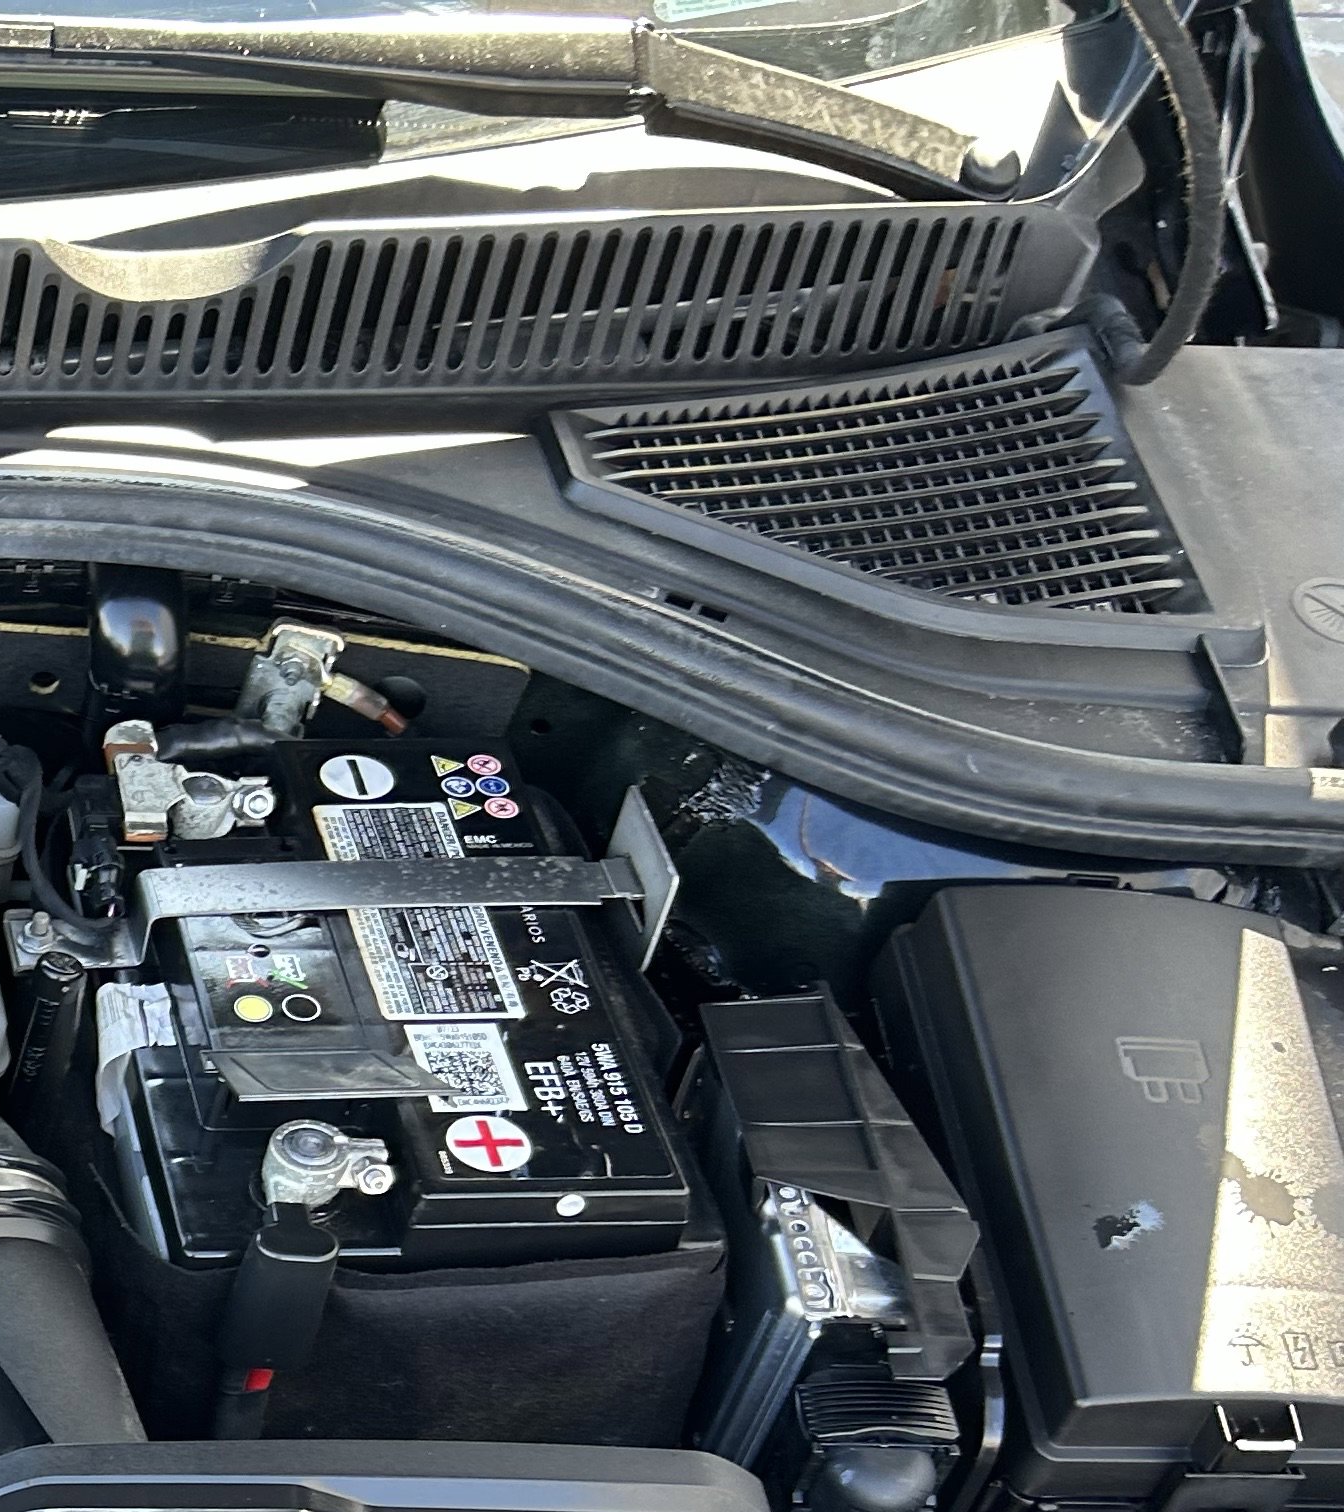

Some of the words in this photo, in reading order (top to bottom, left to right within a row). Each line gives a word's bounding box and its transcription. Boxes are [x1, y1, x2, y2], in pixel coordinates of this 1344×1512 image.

[464, 835, 498, 845] EMC
[590, 1043, 619, 1071] 5WA
[523, 1061, 565, 1117] EFB+
[574, 1051, 593, 1068] 12V
[598, 1111, 617, 1127] DIN
[603, 1072, 629, 1096] 915
[614, 1098, 638, 1122] 105
[623, 1123, 646, 1134] D
